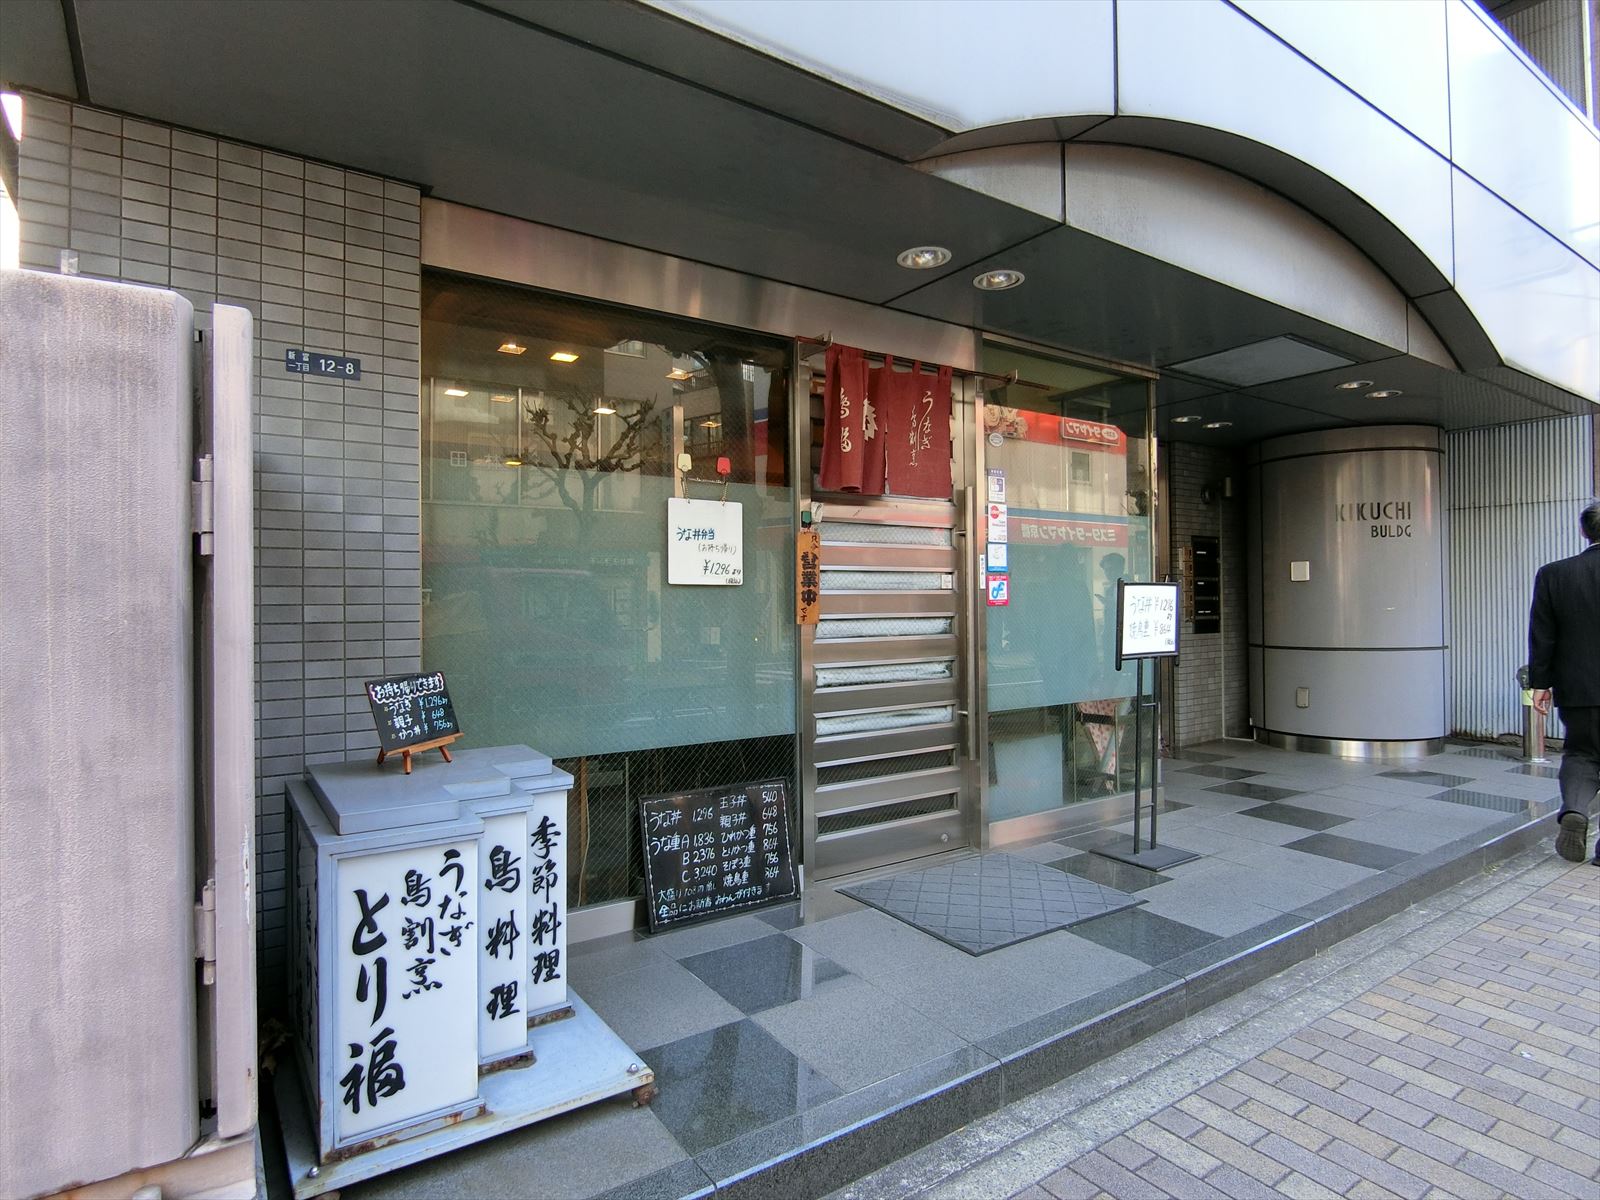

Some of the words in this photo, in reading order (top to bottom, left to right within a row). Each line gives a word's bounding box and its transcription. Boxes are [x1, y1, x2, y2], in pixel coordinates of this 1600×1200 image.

[288, 362, 310, 372] 一丁目
[319, 359, 354, 375] 12-8
[1335, 501, 1411, 521] KIKUCHI
[1371, 525, 1412, 538] BULDG
[801, 552, 818, 606] 営業中
[375, 676, 440, 699] お持ち帰りできます
[394, 714, 413, 729] 親子
[762, 791, 778, 803] 540
[762, 806, 778, 820] 648
[762, 822, 778, 836] 756
[763, 838, 778, 850] 864
[682, 852, 690, 866] B
[764, 852, 779, 864] 756
[682, 870, 691, 883] C
[438, 849, 474, 957] うなぎ
[531, 815, 561, 985] 季節料理
[401, 869, 443, 1000] 鳥割烹
[484, 845, 522, 1021] 鳥料理
[340, 889, 405, 1115] とり福
